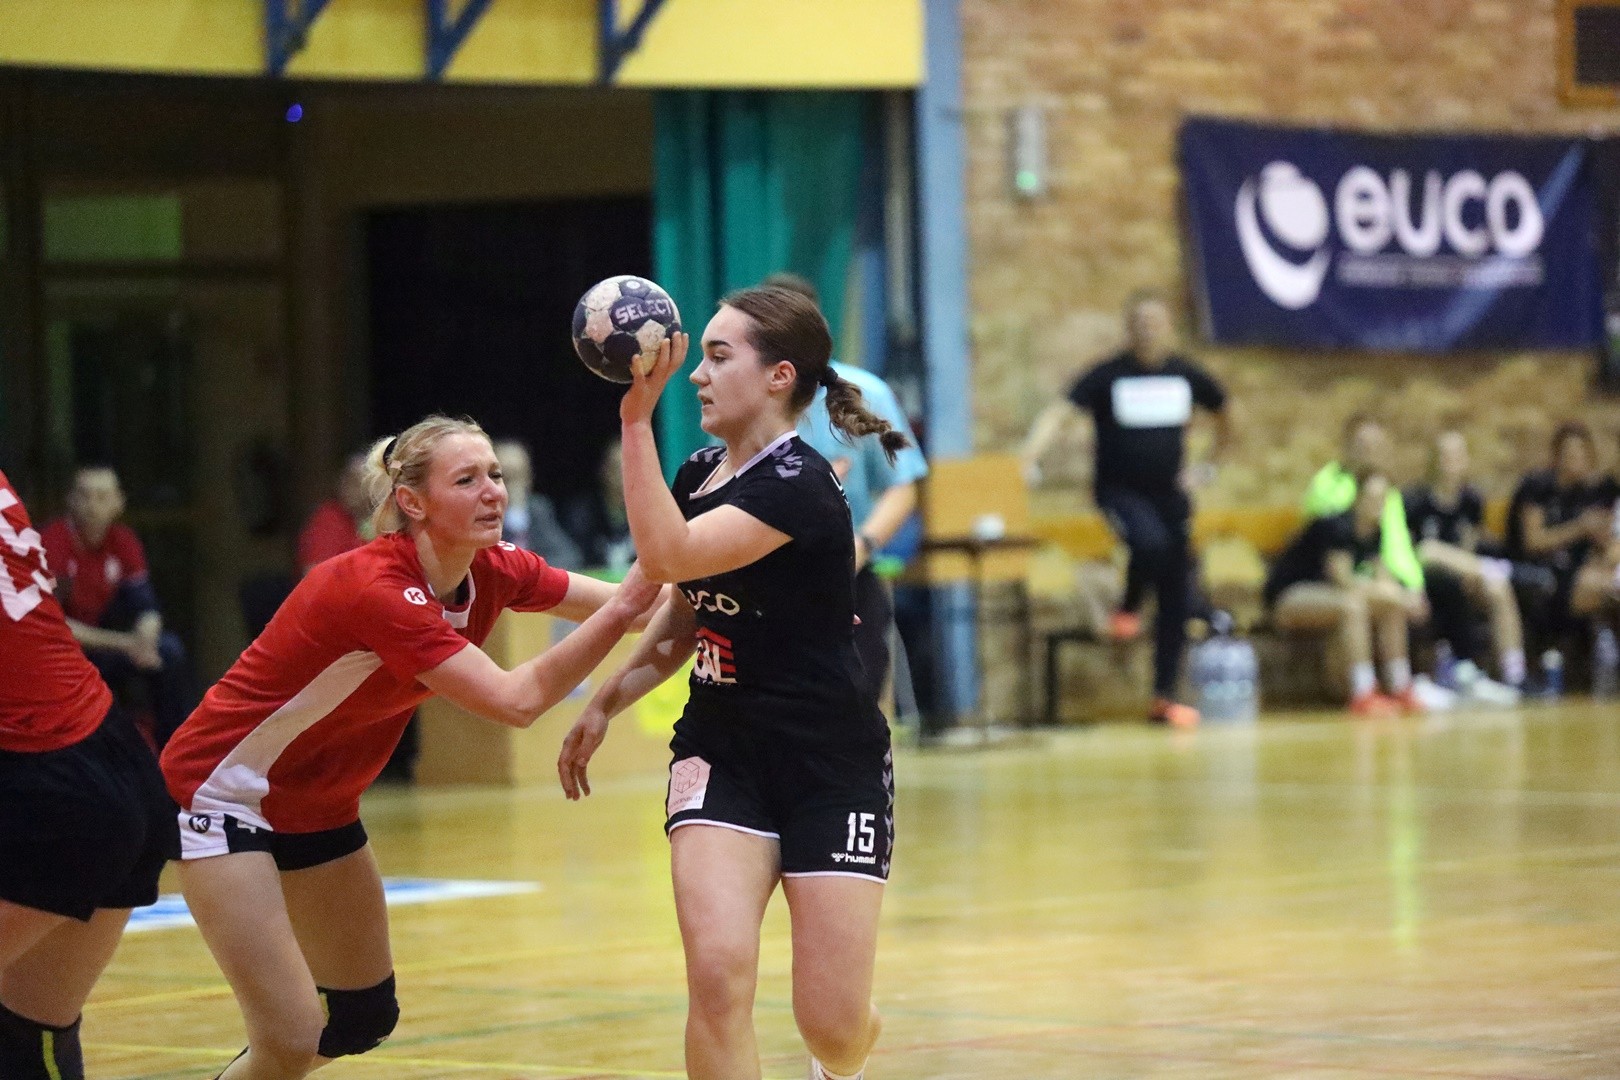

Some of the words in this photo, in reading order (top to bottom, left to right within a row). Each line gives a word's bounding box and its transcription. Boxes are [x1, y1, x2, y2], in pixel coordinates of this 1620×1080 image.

[615, 298, 672, 325] SELECT
[846, 812, 876, 854] 15
[844, 852, 877, 865] hummel
